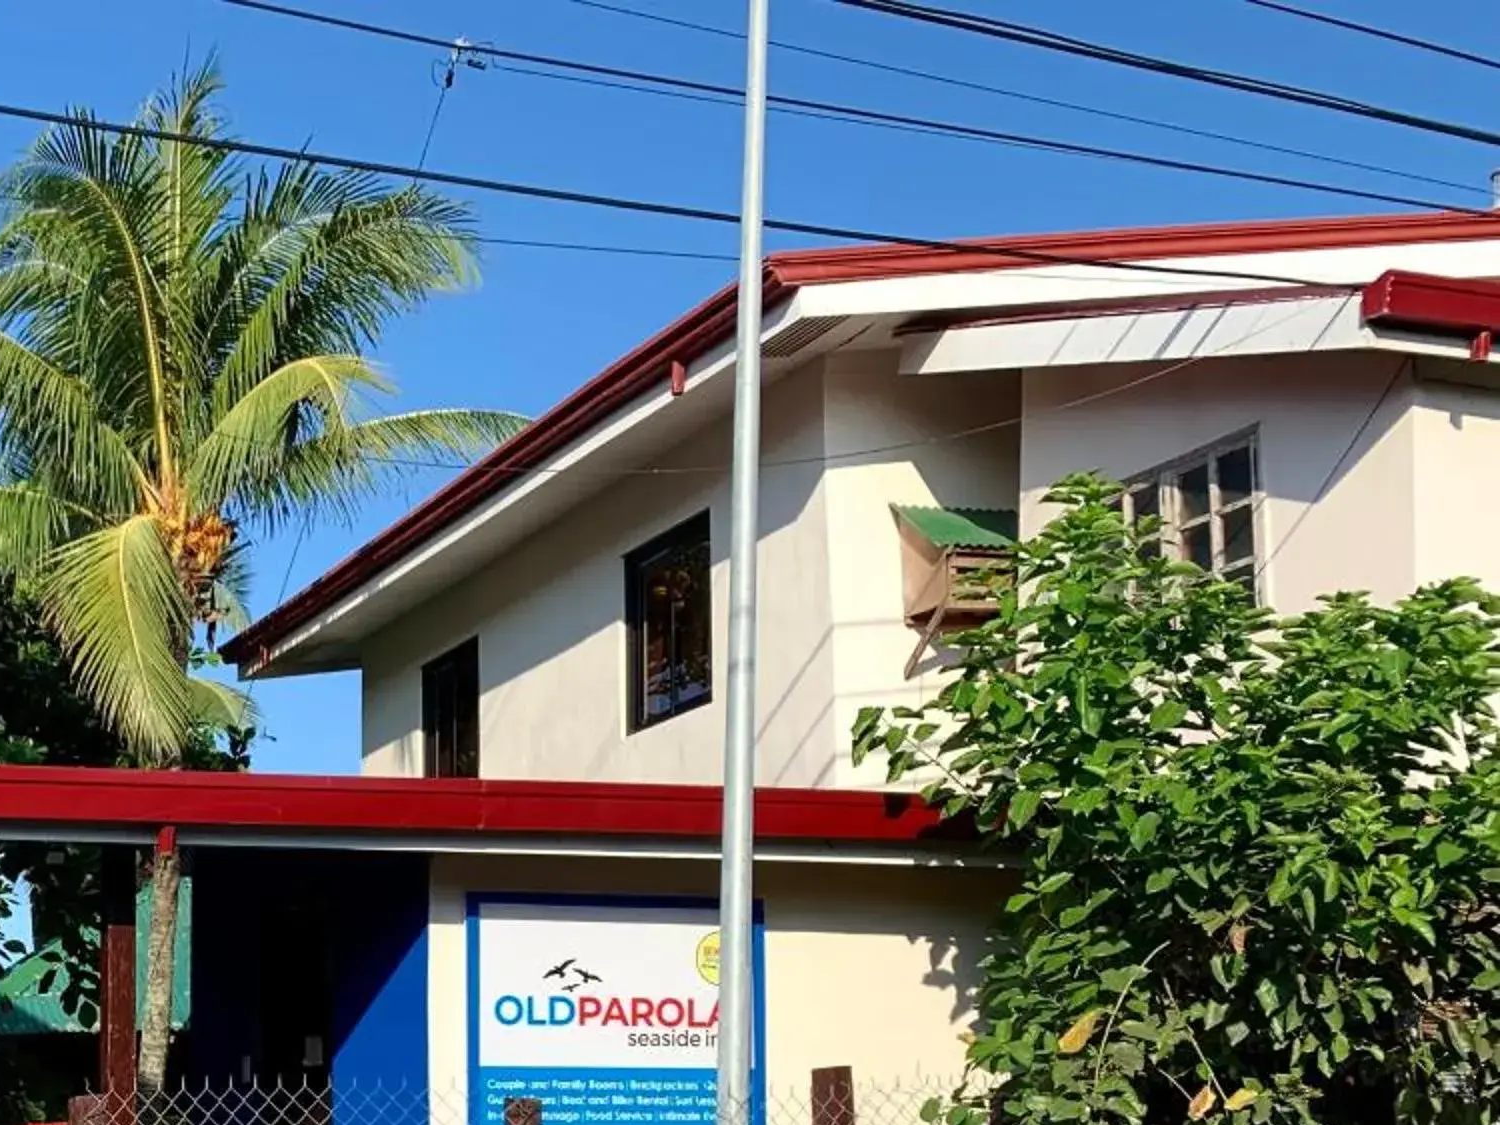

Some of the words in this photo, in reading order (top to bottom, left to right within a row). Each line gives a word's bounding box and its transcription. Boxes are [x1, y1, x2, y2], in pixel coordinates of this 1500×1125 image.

[628, 1030, 701, 1047] seaside
[552, 1079, 586, 1092] Family
[589, 1080, 624, 1090] Rooms
[588, 1095, 610, 1105] and
[636, 1095, 669, 1106] Rental
[586, 1110, 612, 1121] Food
